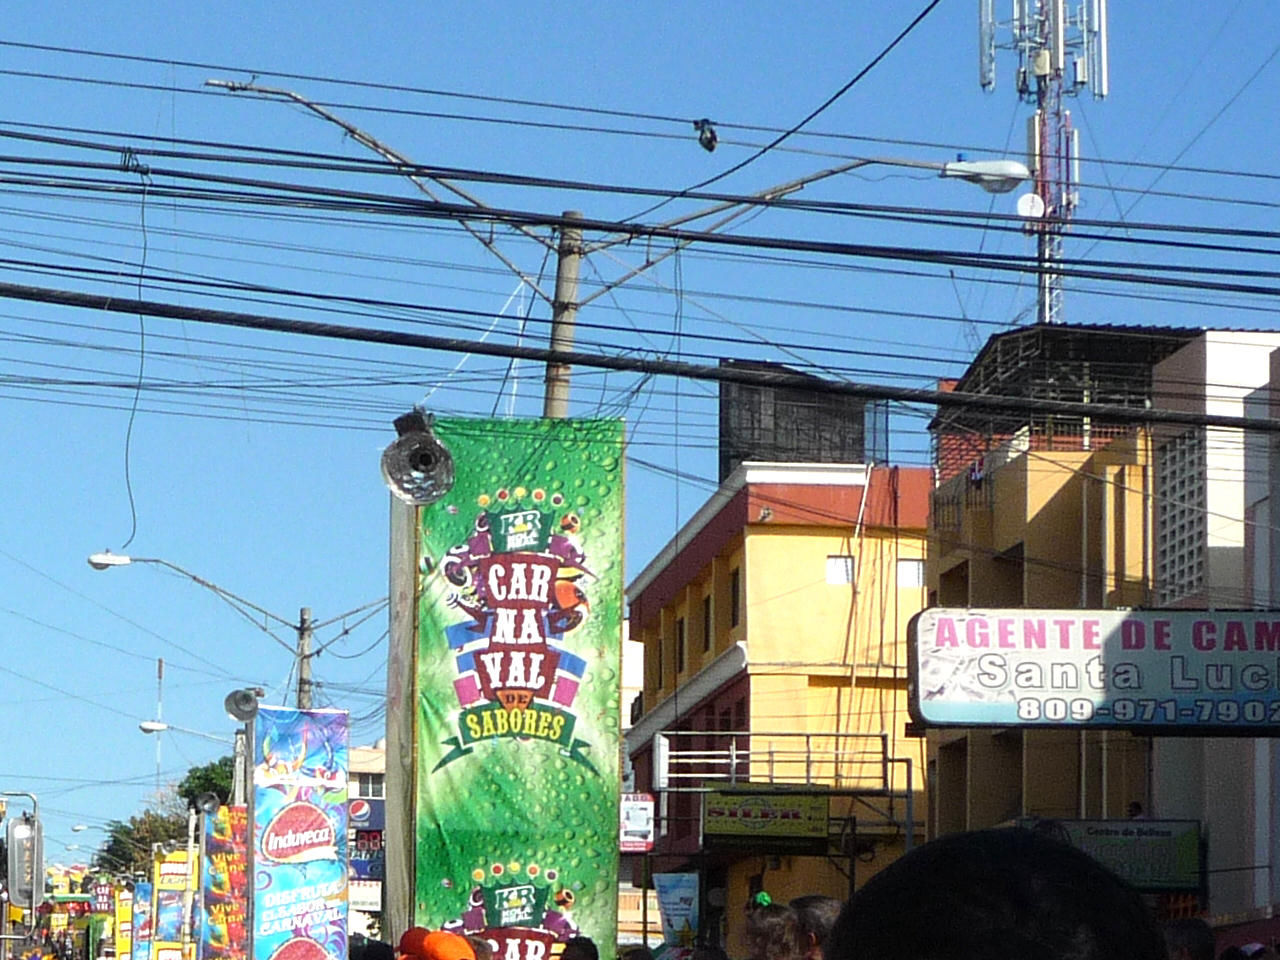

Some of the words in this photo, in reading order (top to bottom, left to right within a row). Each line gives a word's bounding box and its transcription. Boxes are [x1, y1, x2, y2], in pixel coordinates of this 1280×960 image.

[487, 563, 552, 601] CAR
[492, 608, 546, 644] NA
[935, 617, 1101, 650] AGENTE
[1121, 620, 1172, 651] DE
[480, 652, 546, 690] VAL
[977, 652, 1141, 690] Santa
[1171, 655, 1280, 691] Luc
[505, 694, 528, 704] DE
[466, 708, 566, 740] SABORES
[268, 828, 331, 849] Induveca
